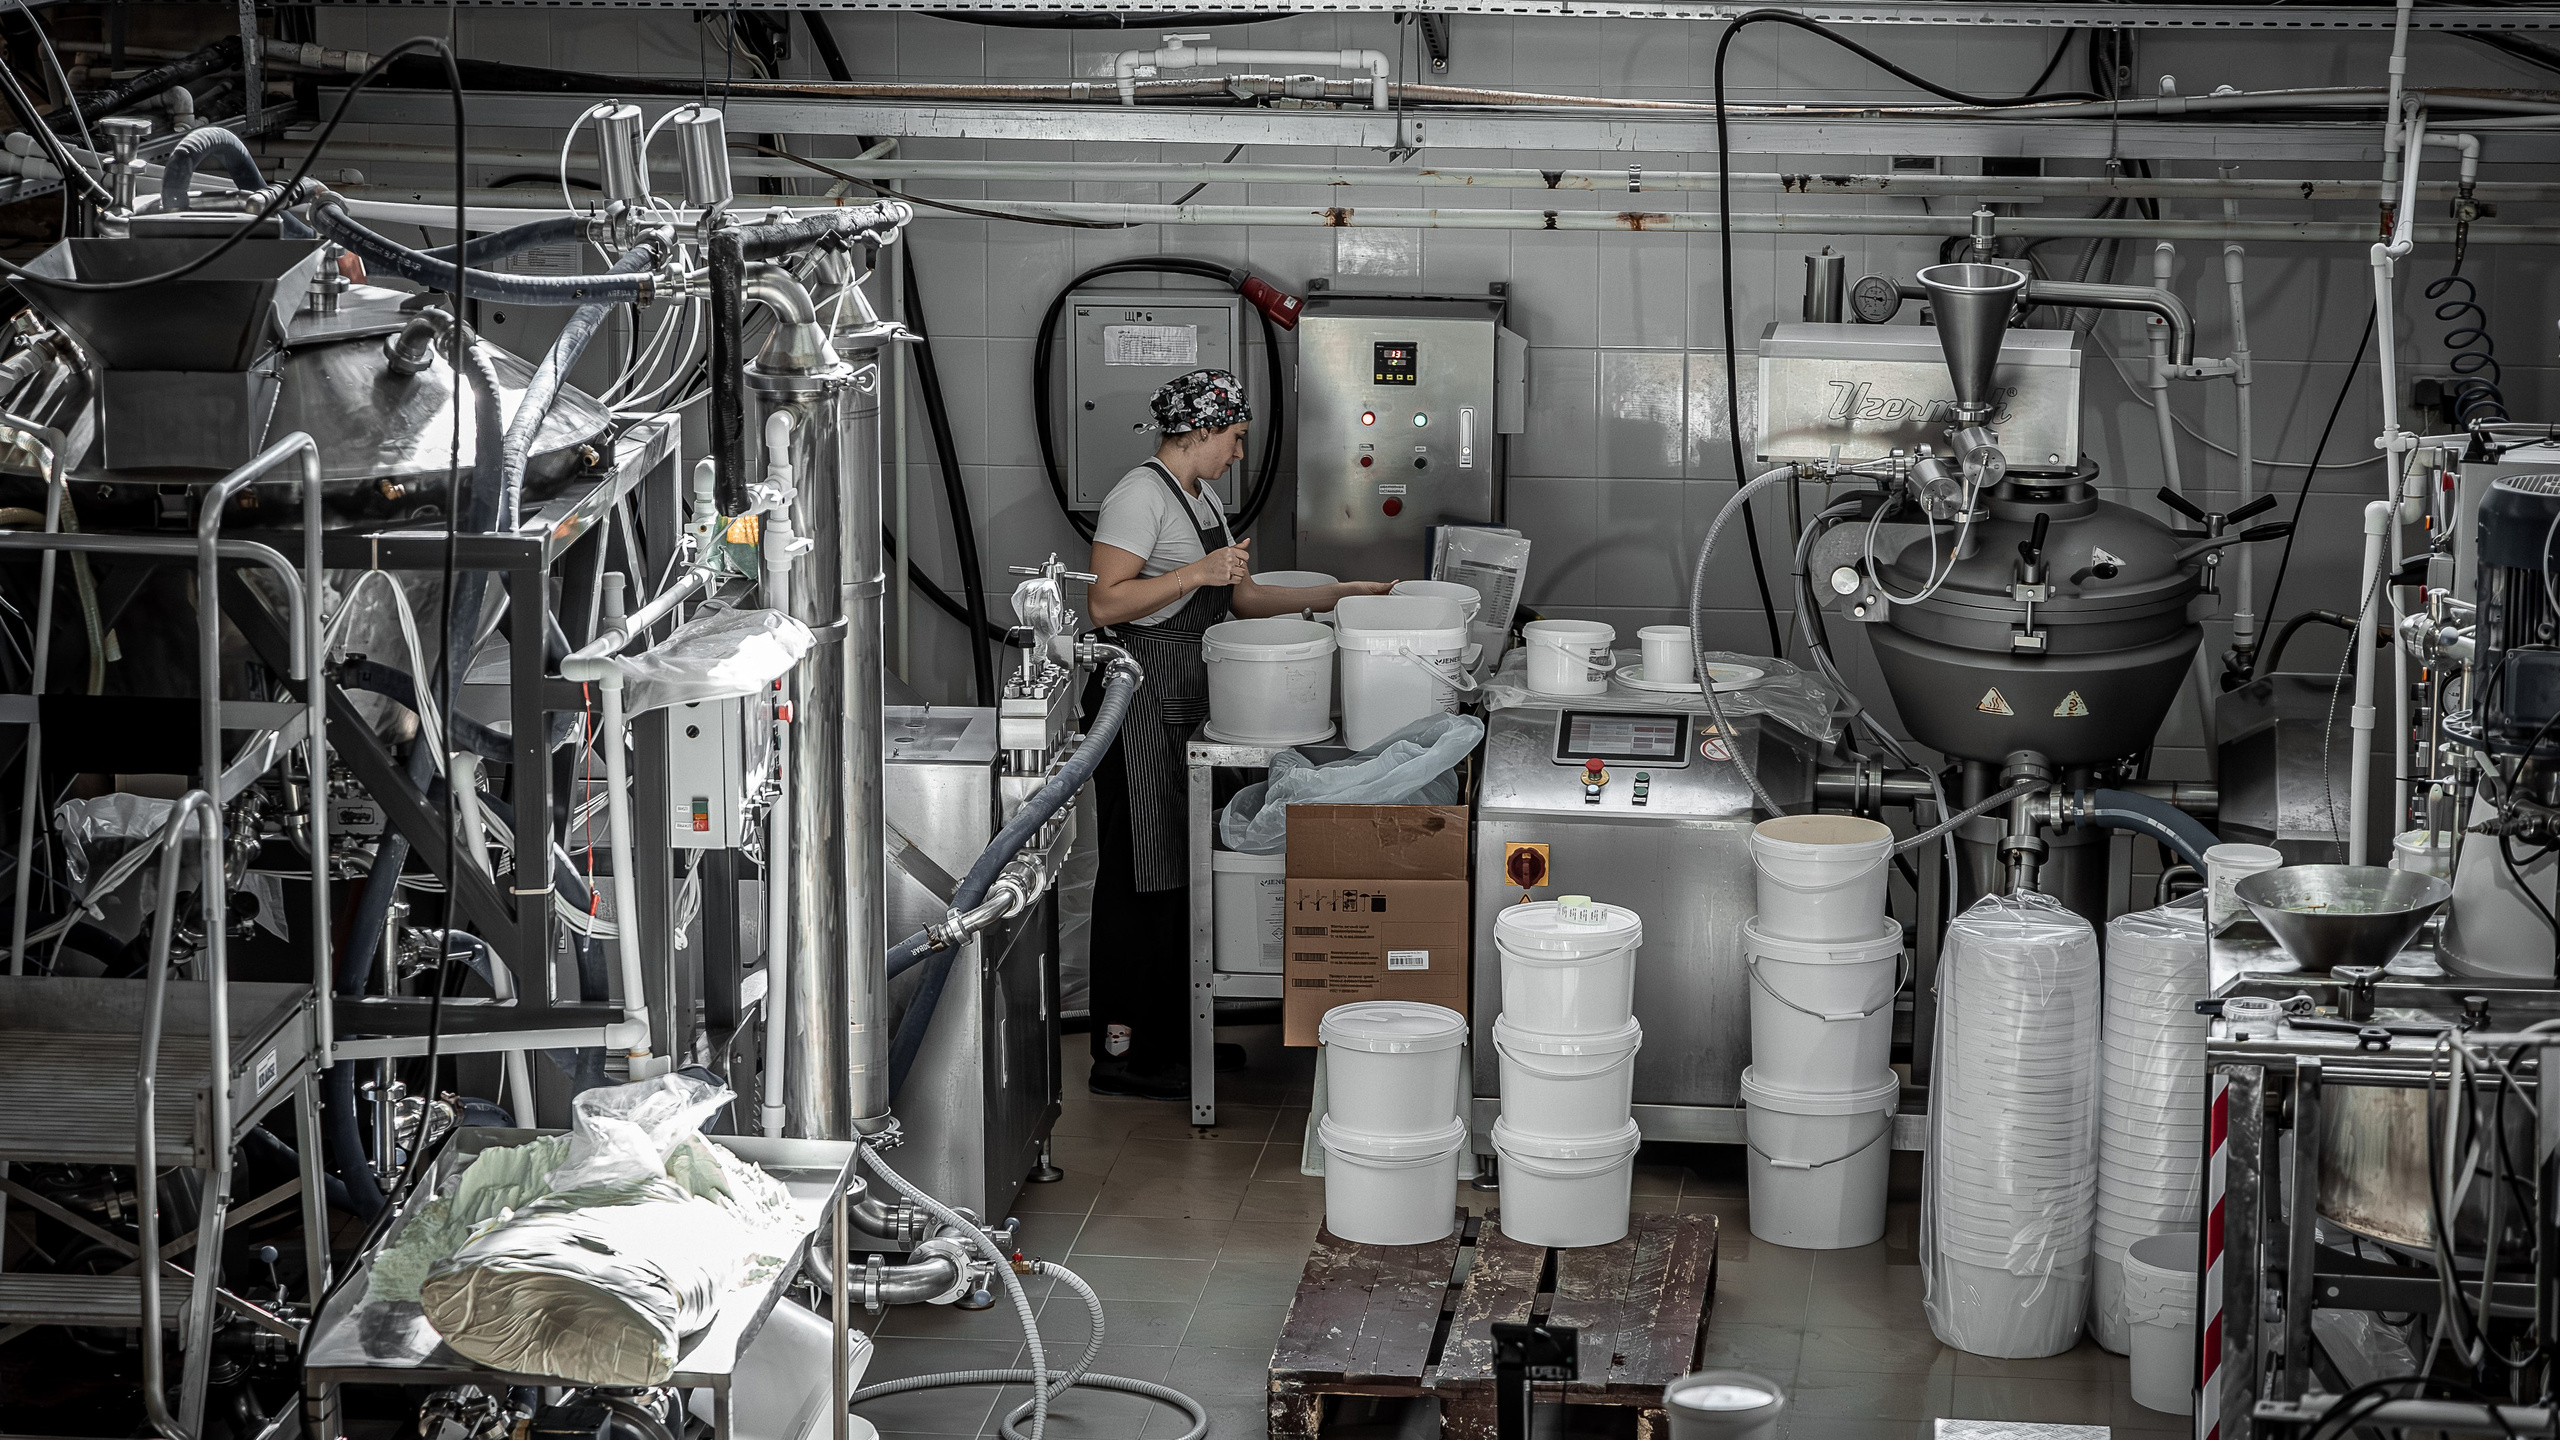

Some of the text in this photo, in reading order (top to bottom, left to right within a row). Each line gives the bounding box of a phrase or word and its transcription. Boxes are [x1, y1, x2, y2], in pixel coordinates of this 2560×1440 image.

[1124, 311, 1153, 323] ЩР 6
[1391, 350, 1402, 359] 13
[1827, 380, 2012, 425] Uzermk
